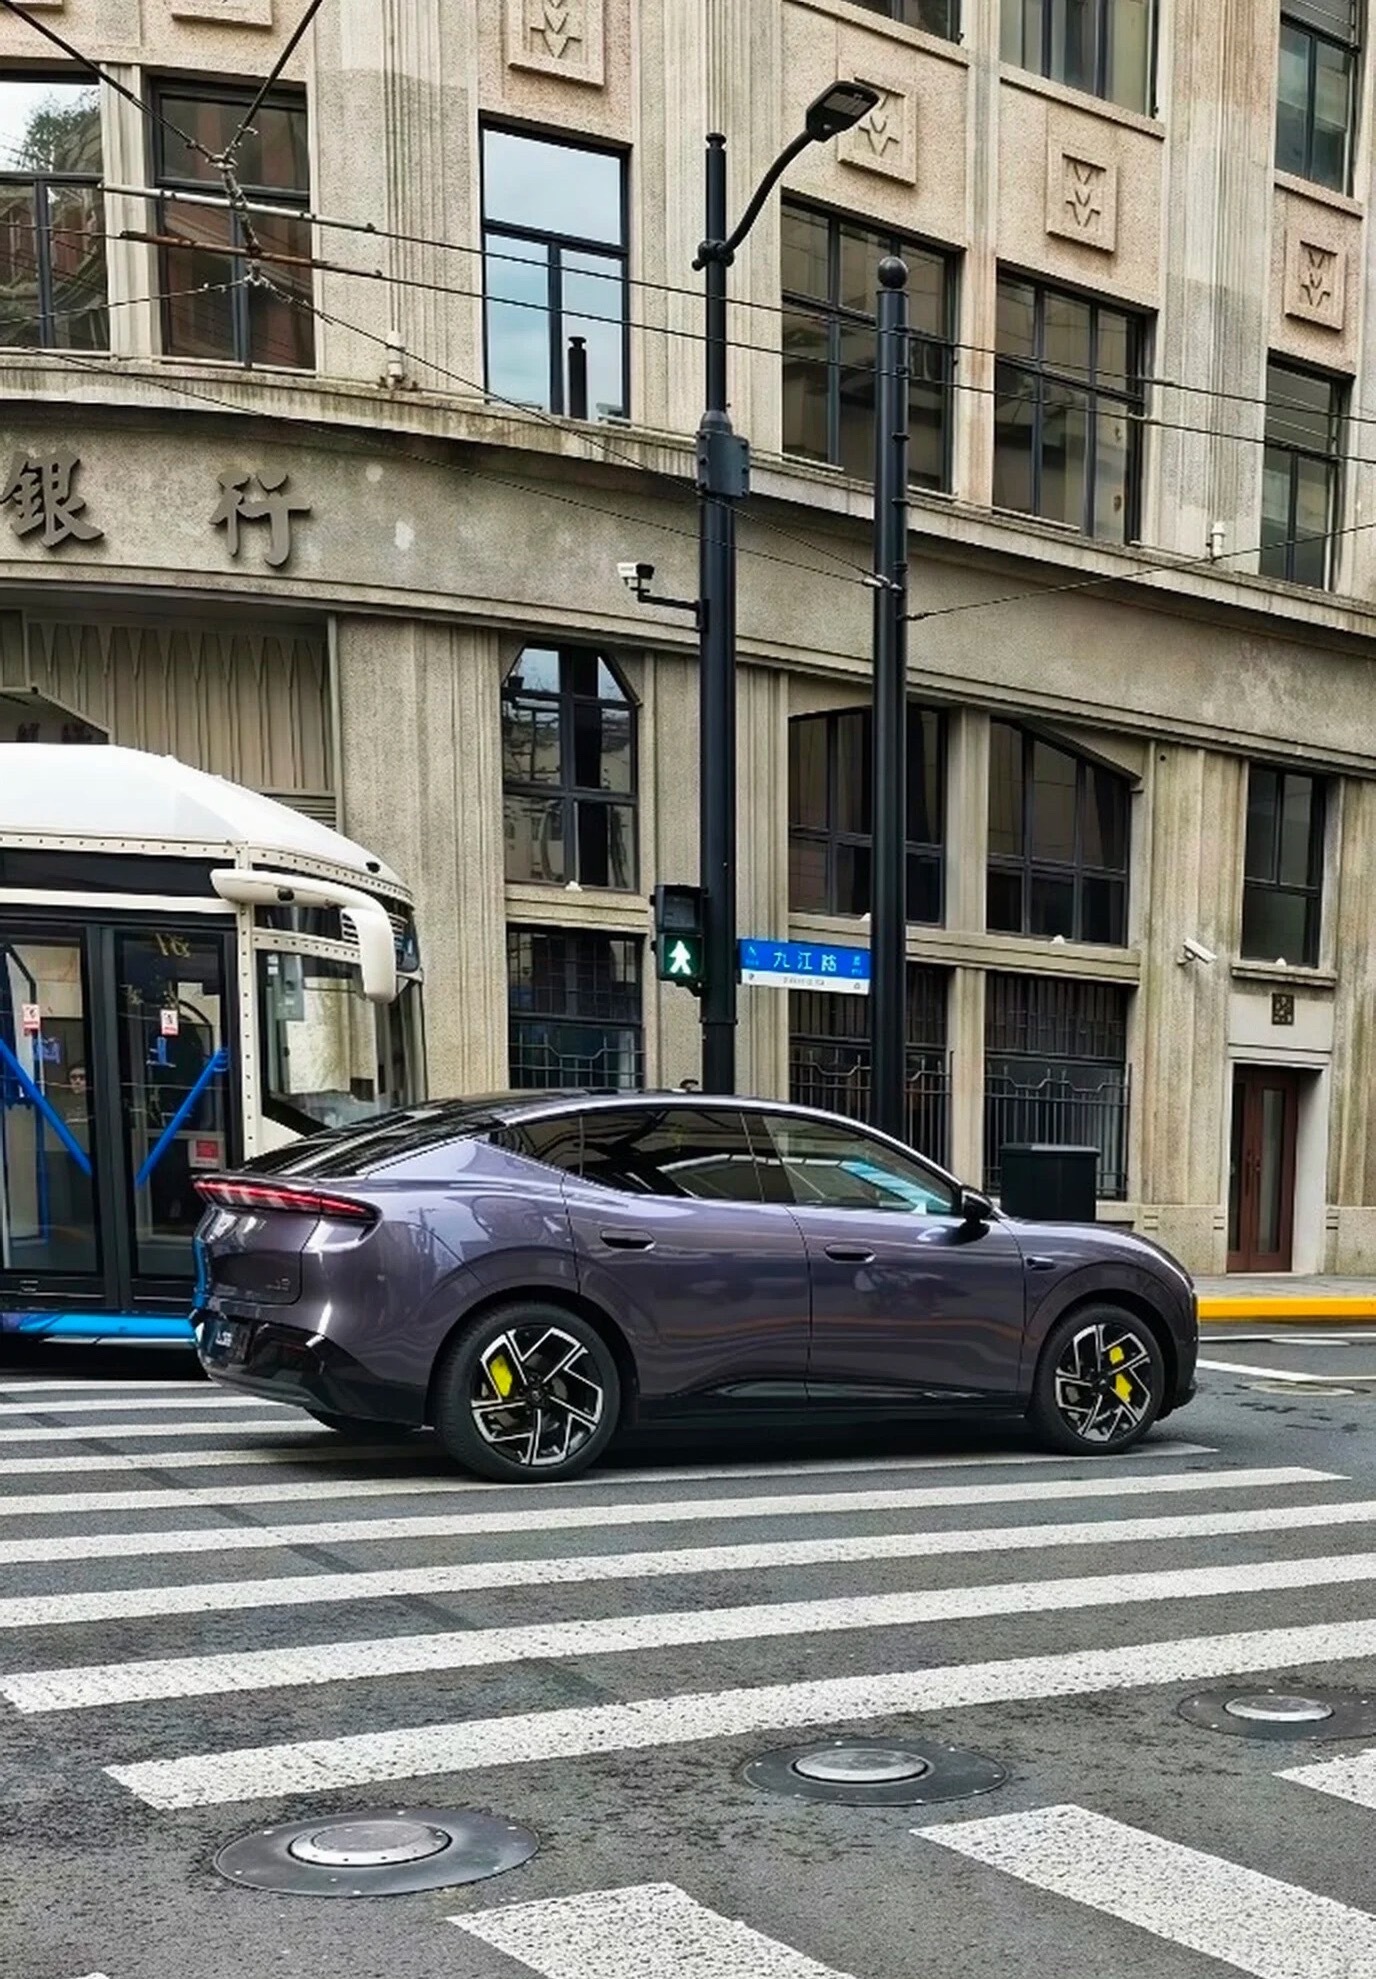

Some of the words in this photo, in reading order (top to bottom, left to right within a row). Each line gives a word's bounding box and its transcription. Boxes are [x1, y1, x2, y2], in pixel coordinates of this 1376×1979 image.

[0, 451, 311, 567] 銀行
[773, 951, 837, 972] 九江路
